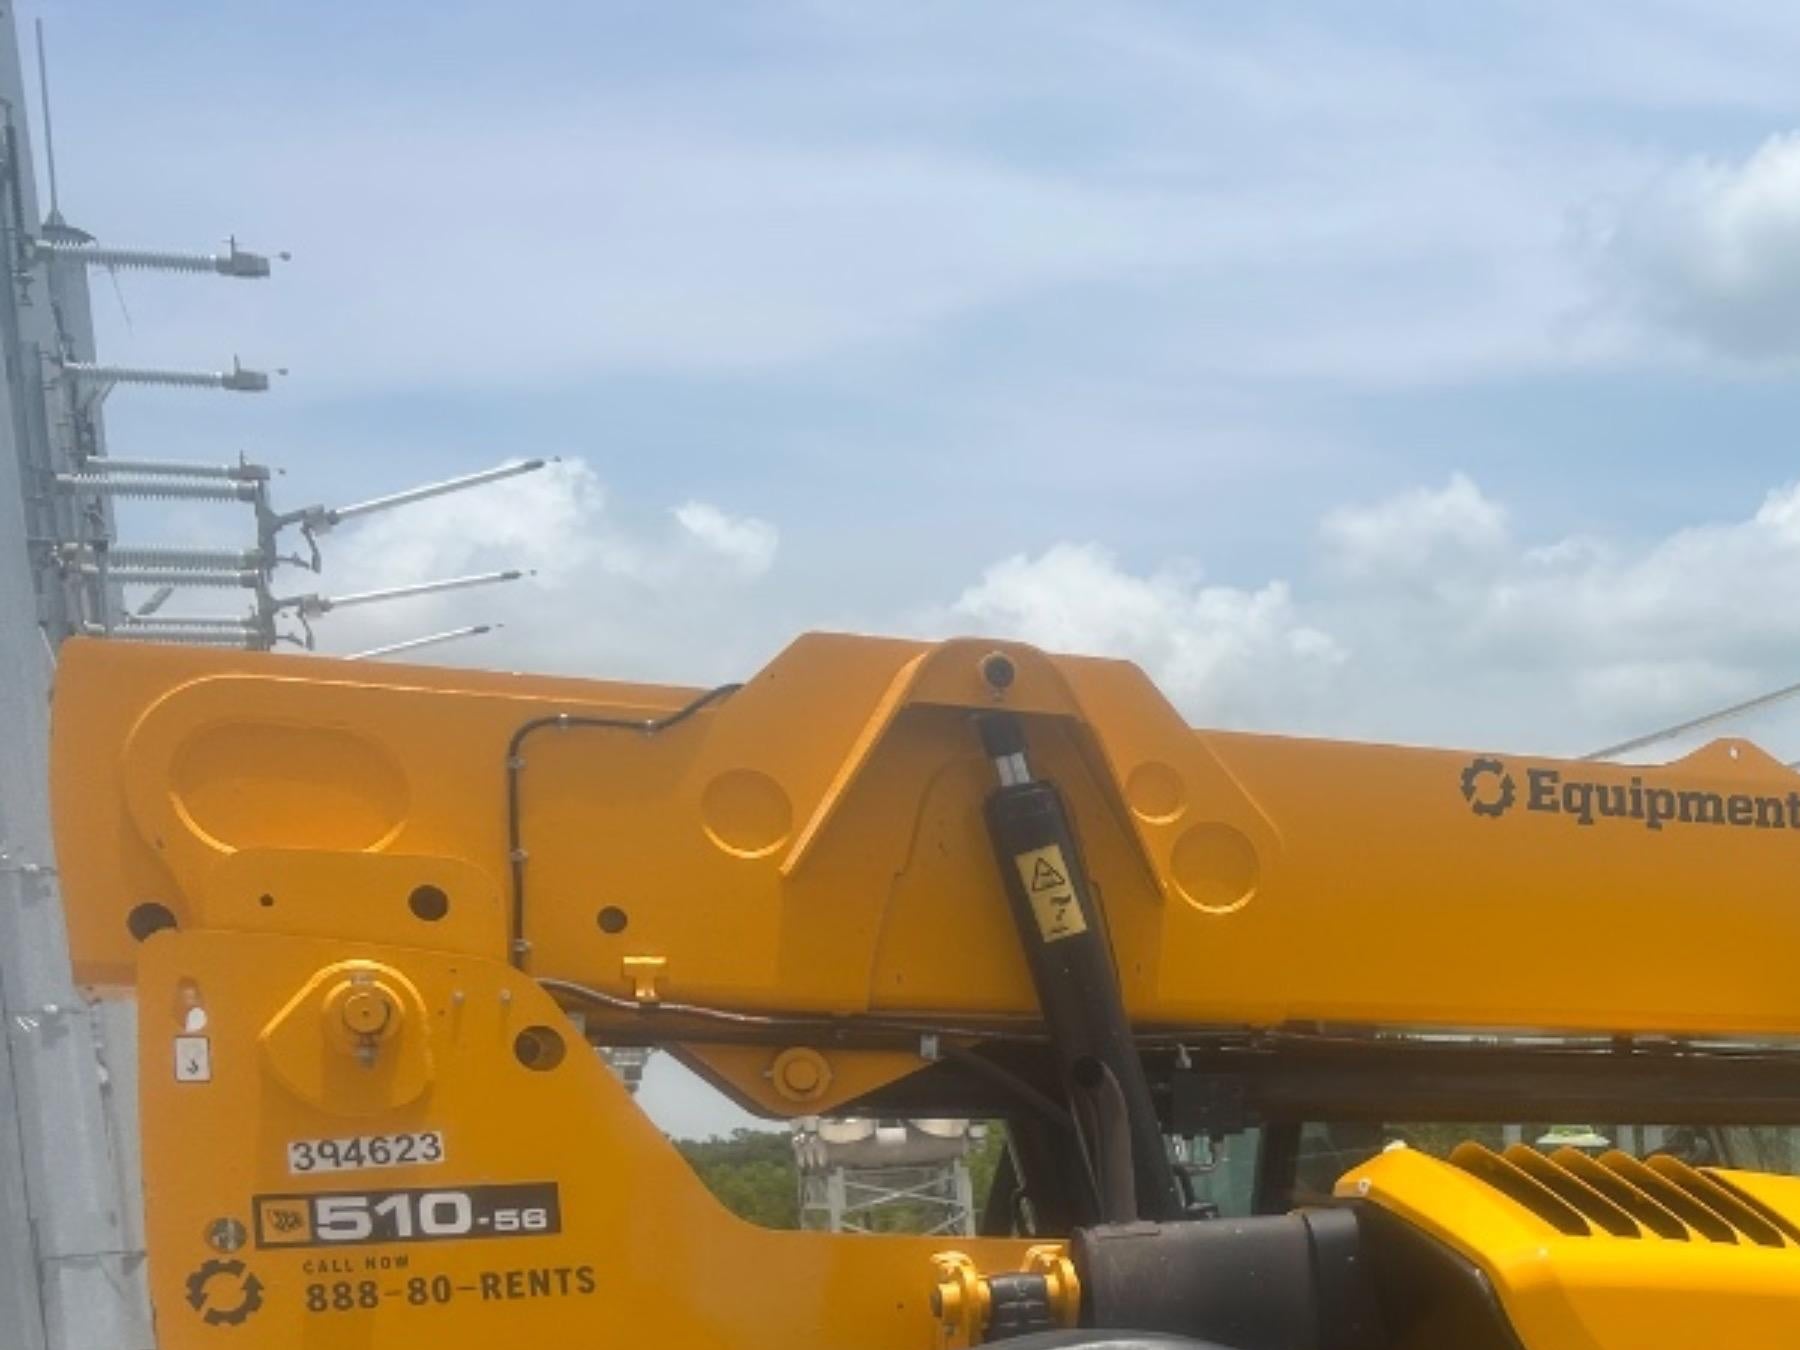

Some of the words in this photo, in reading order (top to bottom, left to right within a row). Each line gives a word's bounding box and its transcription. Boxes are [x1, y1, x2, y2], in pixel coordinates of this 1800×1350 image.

[293, 1132, 442, 1171] 394623
[303, 1258, 355, 1275] CALL
[365, 1256, 409, 1270] NOW
[306, 1265, 596, 1313] 888-80-RENTS
